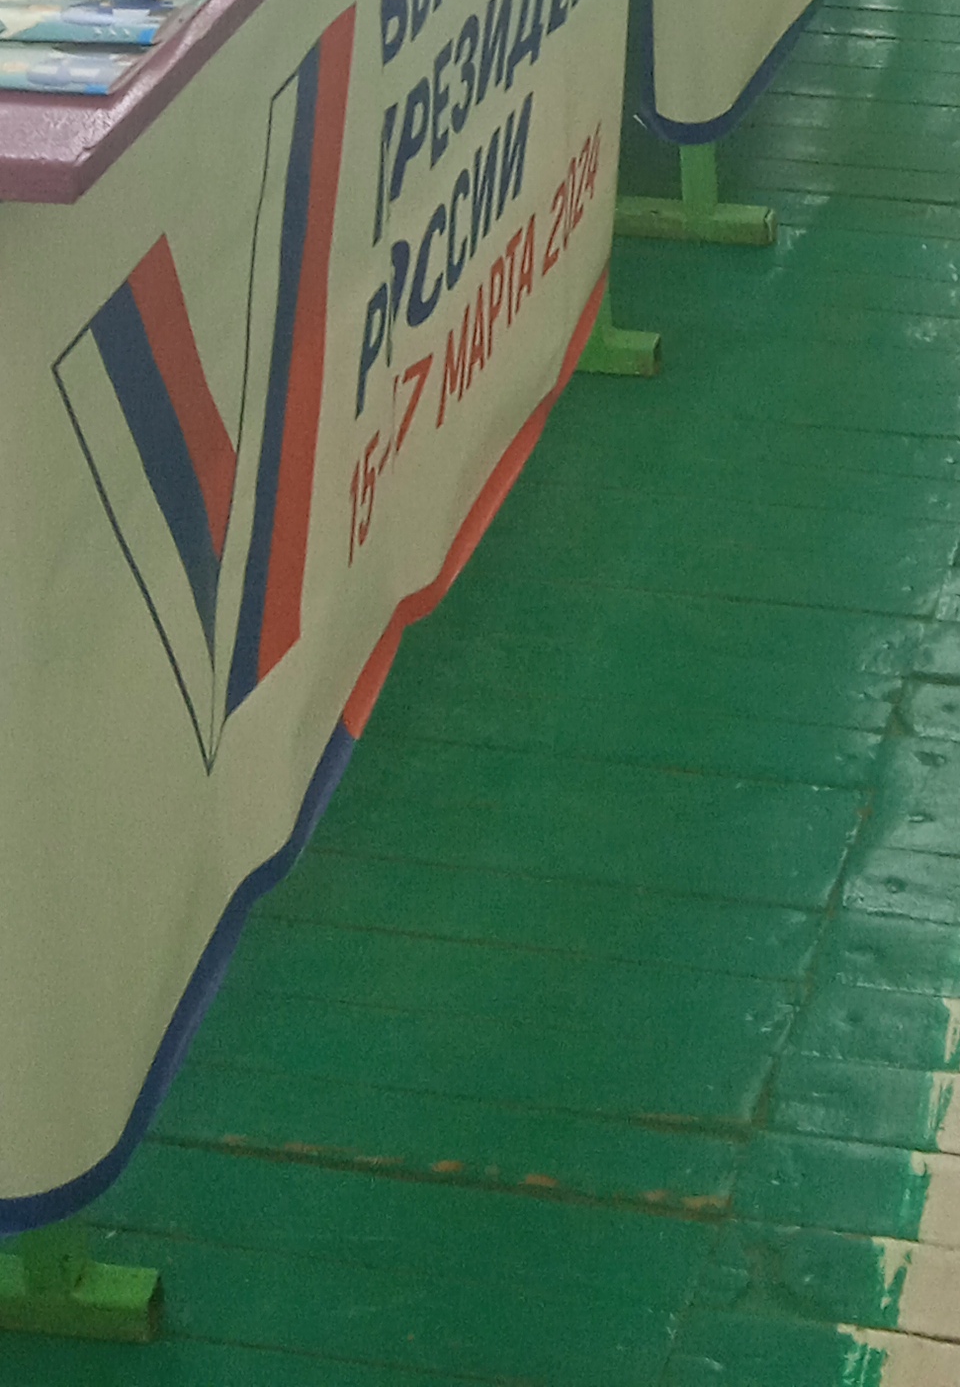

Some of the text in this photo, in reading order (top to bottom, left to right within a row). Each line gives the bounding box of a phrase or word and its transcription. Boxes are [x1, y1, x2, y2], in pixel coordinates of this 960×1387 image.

[354, 91, 534, 420] РОССИИ
[435, 213, 535, 429] МАРТА
[542, 121, 602, 277] 2024
